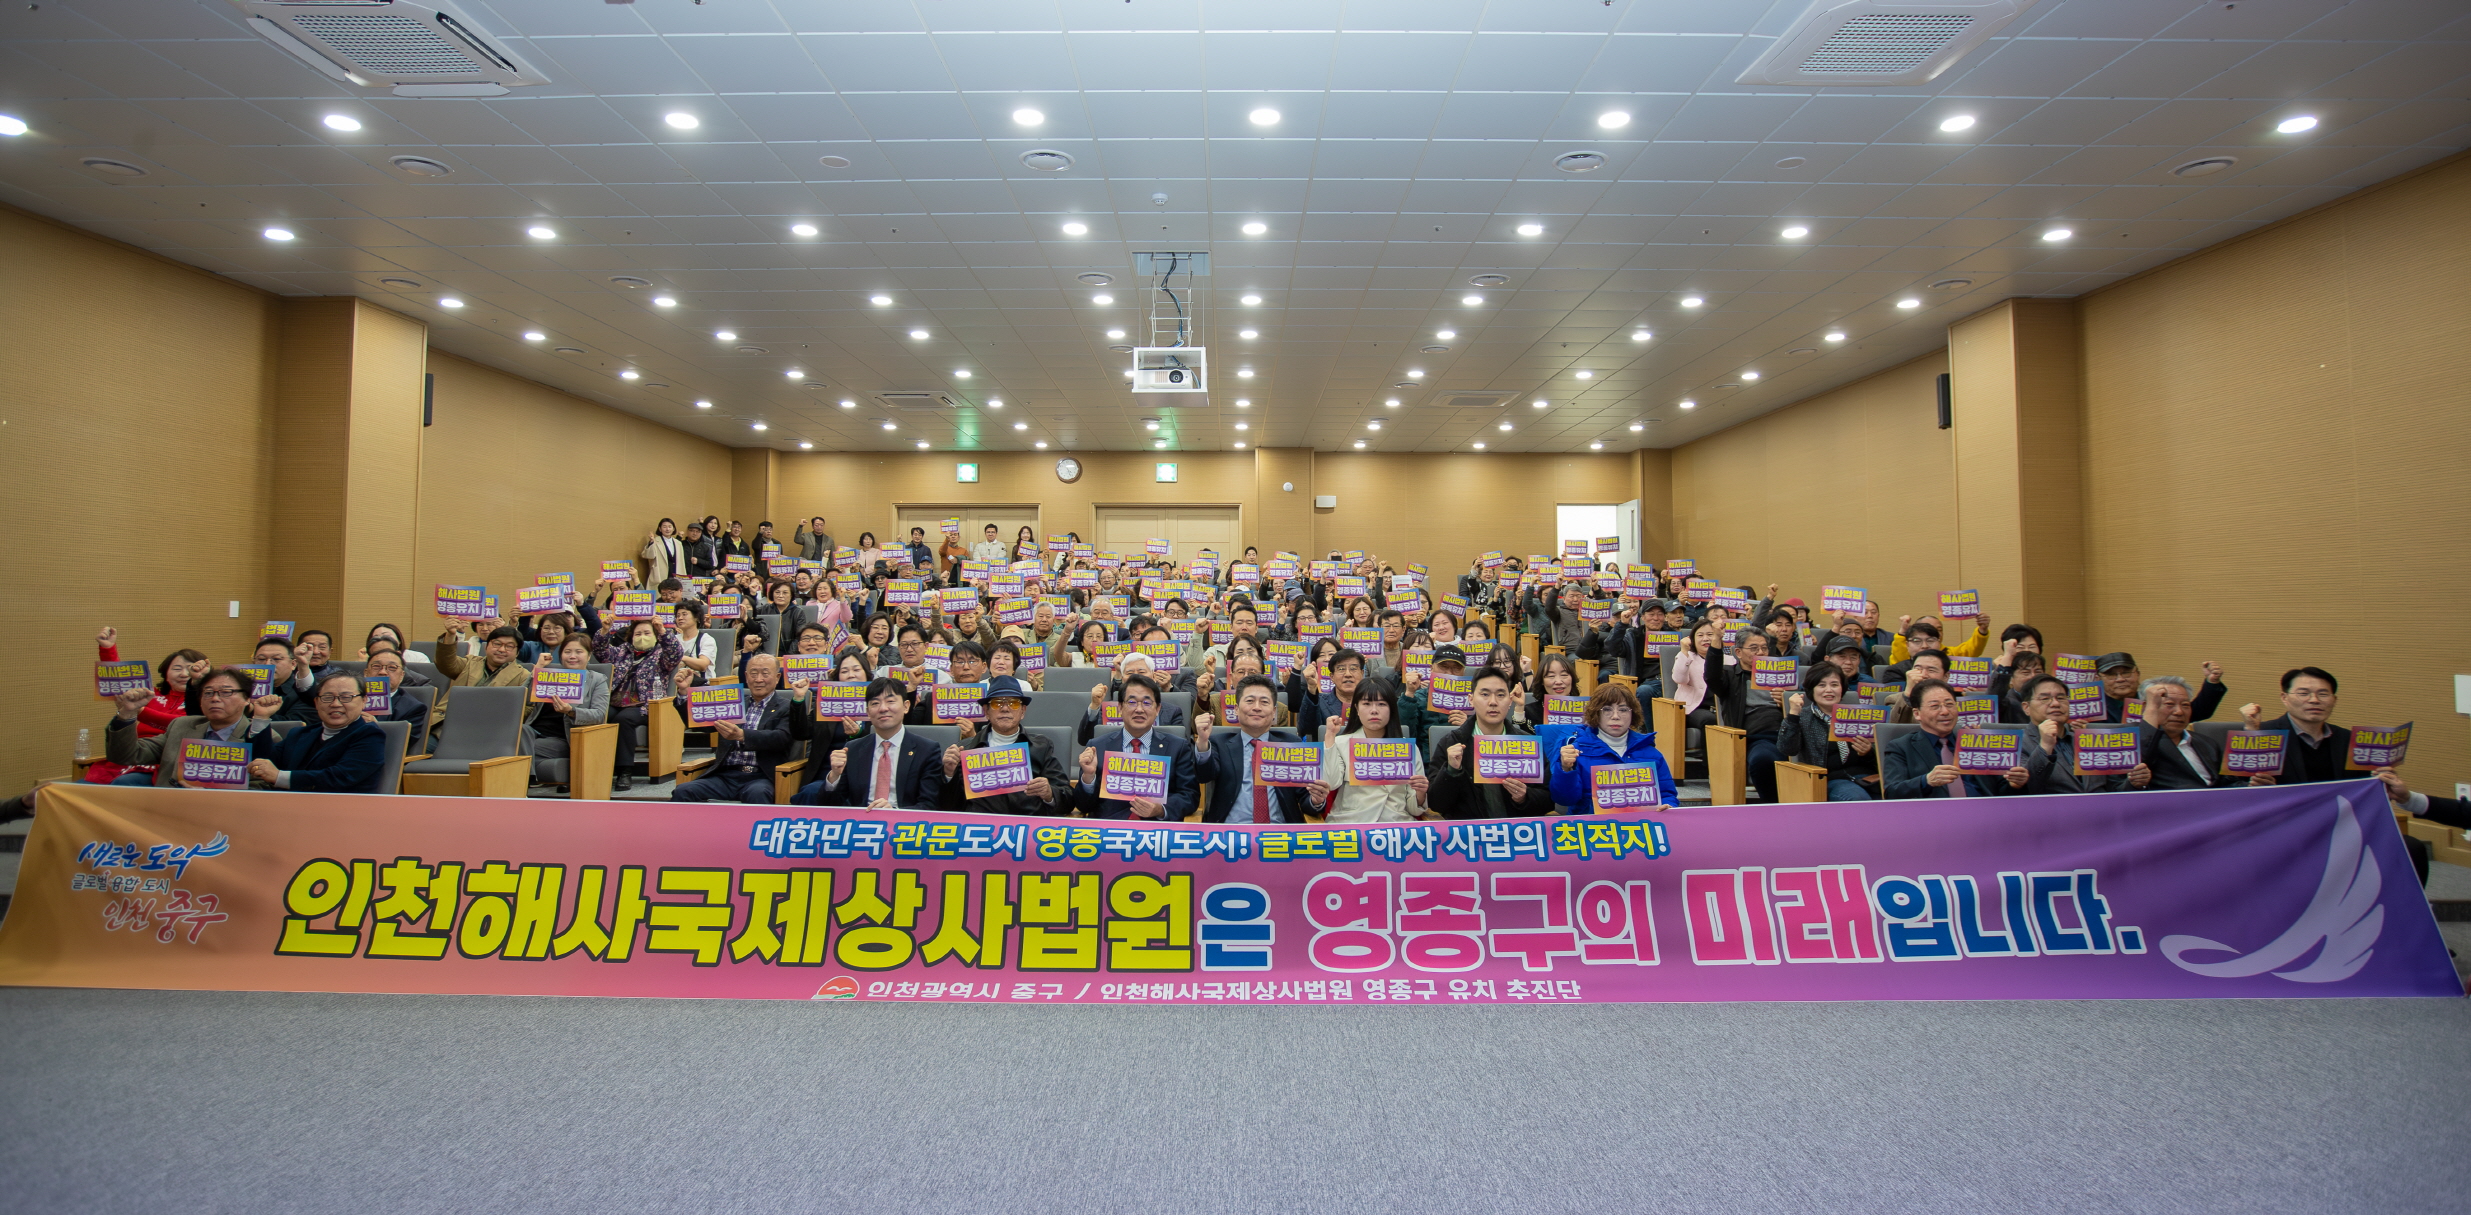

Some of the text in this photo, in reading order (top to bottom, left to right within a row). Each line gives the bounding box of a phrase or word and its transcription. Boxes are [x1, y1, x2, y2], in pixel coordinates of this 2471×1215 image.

[438, 588, 480, 600] 해사법원
[519, 587, 560, 600] 해사법원
[888, 583, 919, 593] 해사법원
[1824, 588, 1862, 600] 해사법원
[616, 594, 652, 603] 해사법원
[942, 590, 975, 601] 해사법원
[1941, 593, 1977, 604] 해사법원
[437, 601, 479, 614] 영종유치
[520, 598, 561, 611] 영종유치
[615, 604, 652, 615] 영종유치
[943, 601, 977, 611] 영종유치
[998, 601, 1030, 612] 해사법원
[1254, 604, 1275, 613] 사법원
[1823, 599, 1862, 611] 영종유치
[1941, 603, 1978, 616] 영종유치
[1000, 610, 1032, 622] 영종유치
[1170, 622, 1195, 631] 사법원
[1301, 625, 1333, 634] 해사법원
[1343, 630, 1380, 641] 해사법원
[1648, 634, 1679, 643] 해사법원
[1020, 647, 1043, 658] 사법원
[1095, 644, 1132, 655] 해사법원
[1136, 644, 1176, 655] 해사법원
[1269, 643, 1307, 655] 해사법원
[787, 658, 829, 669] 해사법원
[1269, 656, 1296, 668] 영종유
[1406, 654, 1433, 665] 해사법
[1755, 660, 1795, 671] 해사법원
[98, 665, 145, 678] 해사법원
[538, 671, 581, 684] 해사법원
[787, 671, 829, 682] 영종유치
[892, 671, 934, 683] 해사원
[1434, 677, 1472, 693] 해사법원
[1755, 673, 1795, 685] 영종유치
[536, 684, 580, 697] 영종유치
[691, 688, 739, 703] 해사법원
[821, 685, 867, 698] 해사법원
[936, 687, 983, 700] 해사법원
[691, 704, 740, 719] 영종유치
[820, 701, 867, 714] 영종유치
[937, 702, 983, 716] 영종유치
[1548, 699, 1590, 714] 해사법
[1957, 699, 1992, 714] 사법원
[1836, 708, 1885, 721] 해사법원
[1961, 734, 2016, 749] 해사법원
[2079, 733, 2135, 749] 해사법원
[2231, 735, 2282, 750] 해사법원
[2356, 731, 2409, 745] 해사법원
[186, 743, 246, 762] 해사법원
[1353, 743, 1410, 758] 해사법원
[1479, 739, 1537, 756] 해사법원
[966, 748, 1024, 770] 해사법원
[1261, 746, 1318, 763] 해사법원
[1959, 752, 2015, 768] 영종유치
[2079, 751, 2136, 767] 영종유치
[2228, 753, 2280, 769] 영종유치
[2353, 747, 2405, 763] 영종유치
[184, 762, 243, 780] 영종유치
[1107, 757, 1163, 776] 해사법원
[1260, 764, 1318, 781] 영종유치
[1353, 761, 1410, 777] 영종유치
[1479, 759, 1537, 776] 영종유치
[968, 768, 1026, 790] 영종유치
[1596, 767, 1652, 786] 해사법원
[1105, 774, 1161, 795] 영종유치
[1597, 786, 1654, 805] 영종유치
[752, 819, 1668, 860] 대한민국 관문도시 영종국제도시! 글로벌 해사 사법의 최적지!
[77, 831, 230, 881] 새로운 도약
[71, 872, 171, 895] 글로벌 융합 도시
[102, 889, 230, 944] 인천 중구
[275, 857, 2149, 973] 인천해사국제상사법원은 영종구의 미래입니다.
[866, 979, 1582, 1001] 인천광역시 중구 / 인천해사국제상사법원 영종구 유치 추진단
